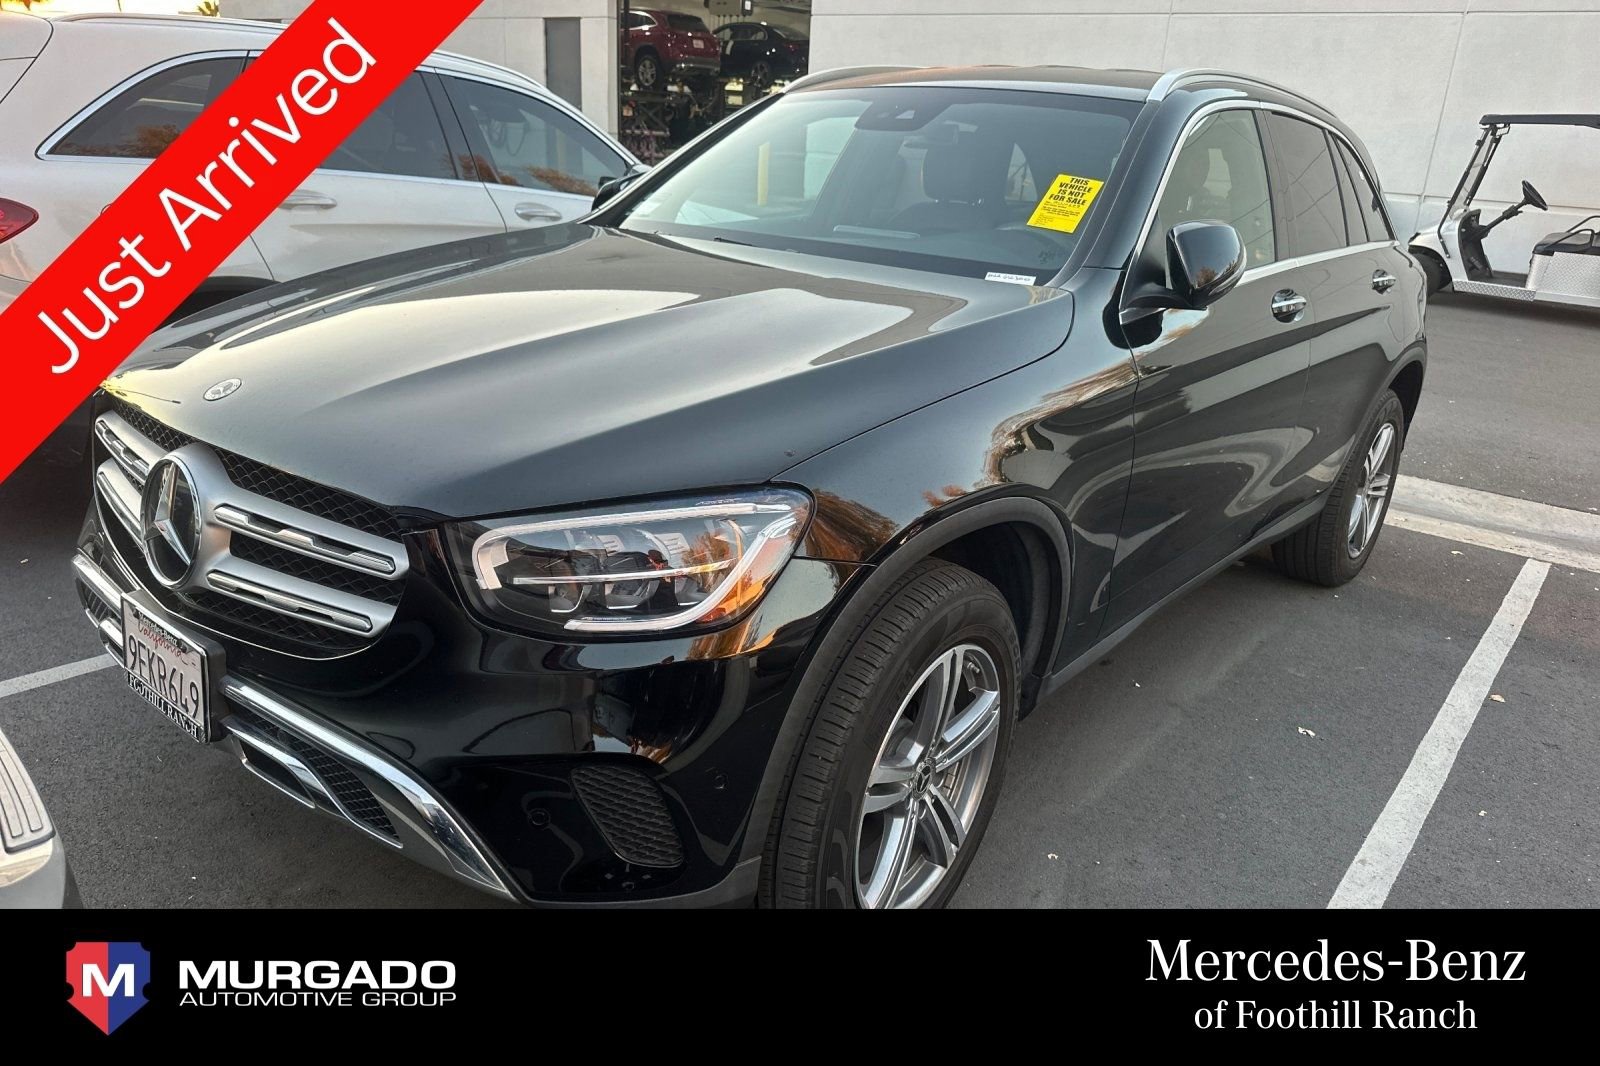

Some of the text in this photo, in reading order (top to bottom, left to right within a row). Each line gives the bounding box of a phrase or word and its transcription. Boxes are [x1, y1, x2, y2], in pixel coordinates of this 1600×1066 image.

[1069, 177, 1090, 186] THIS
[1059, 182, 1093, 193] VEHICLE
[1068, 190, 1086, 198] NOT
[1048, 194, 1066, 202] FOR
[1066, 196, 1088, 206] SALE
[128, 635, 200, 721] 9EKR649
